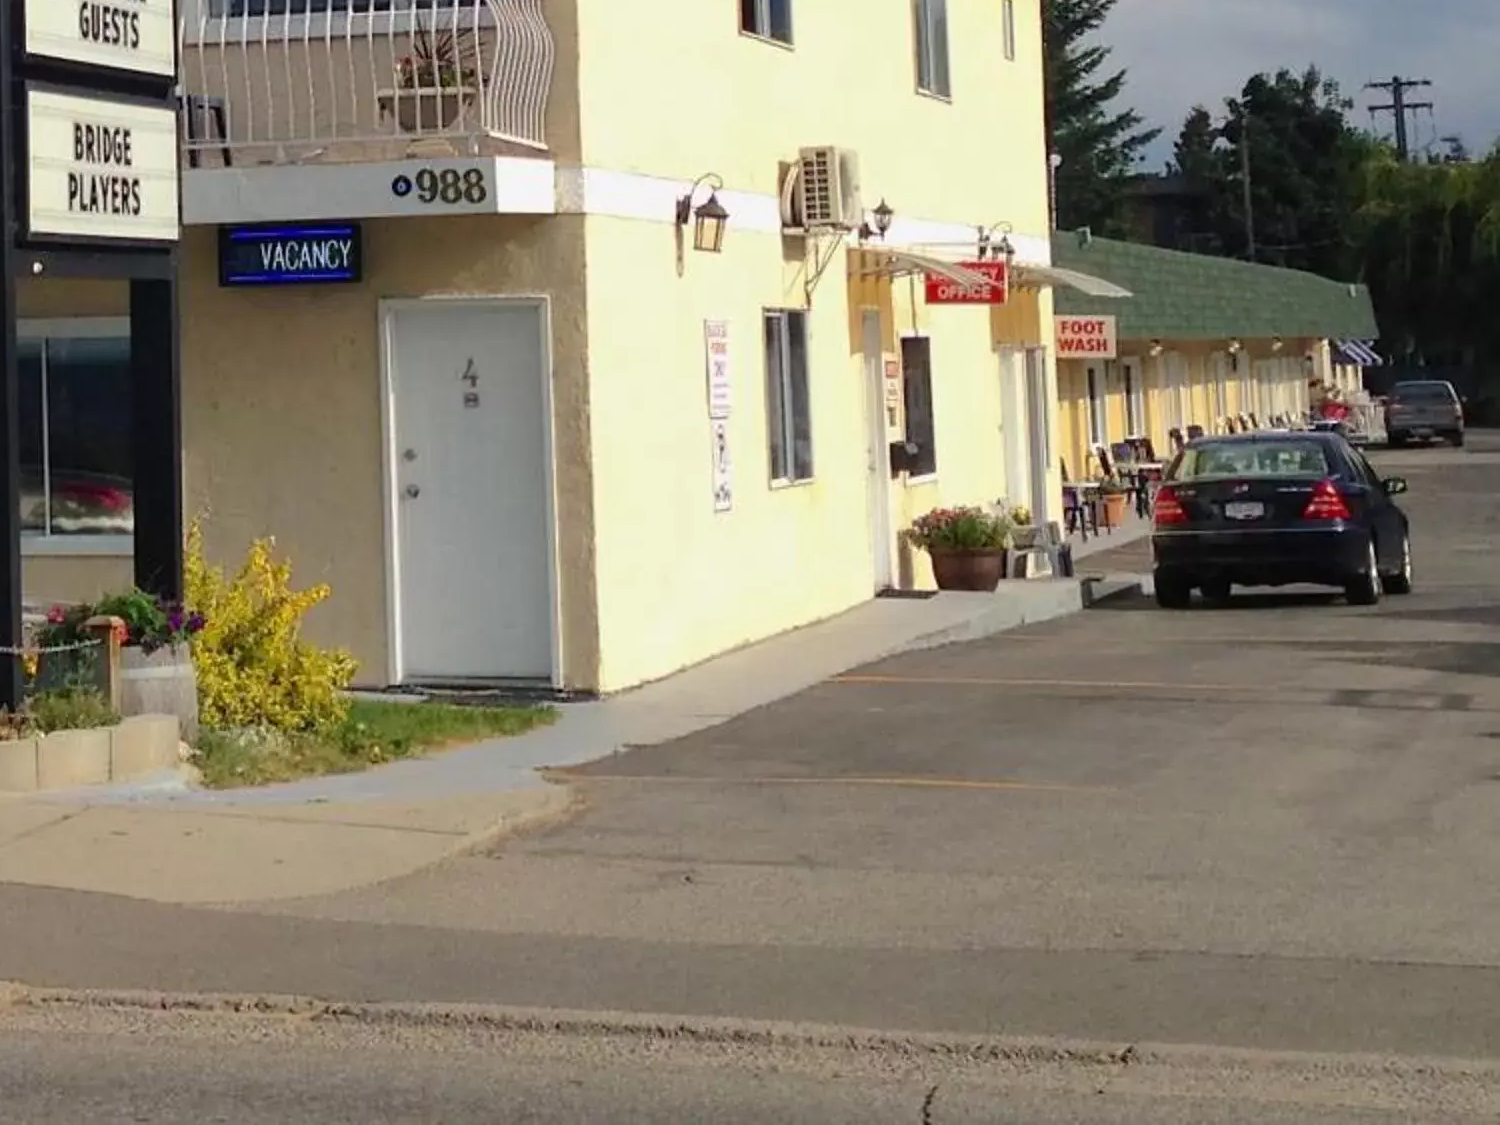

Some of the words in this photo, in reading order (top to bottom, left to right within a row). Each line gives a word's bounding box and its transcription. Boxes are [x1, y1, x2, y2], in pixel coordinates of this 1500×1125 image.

[79, 1, 140, 49] GUESTS
[74, 122, 132, 166] BRIDGE
[68, 171, 141, 216] PLAYERS
[415, 168, 487, 204] 988
[260, 239, 352, 271] VACANCY
[1056, 337, 1108, 352] WASH
[1060, 320, 1106, 335] FOOT
